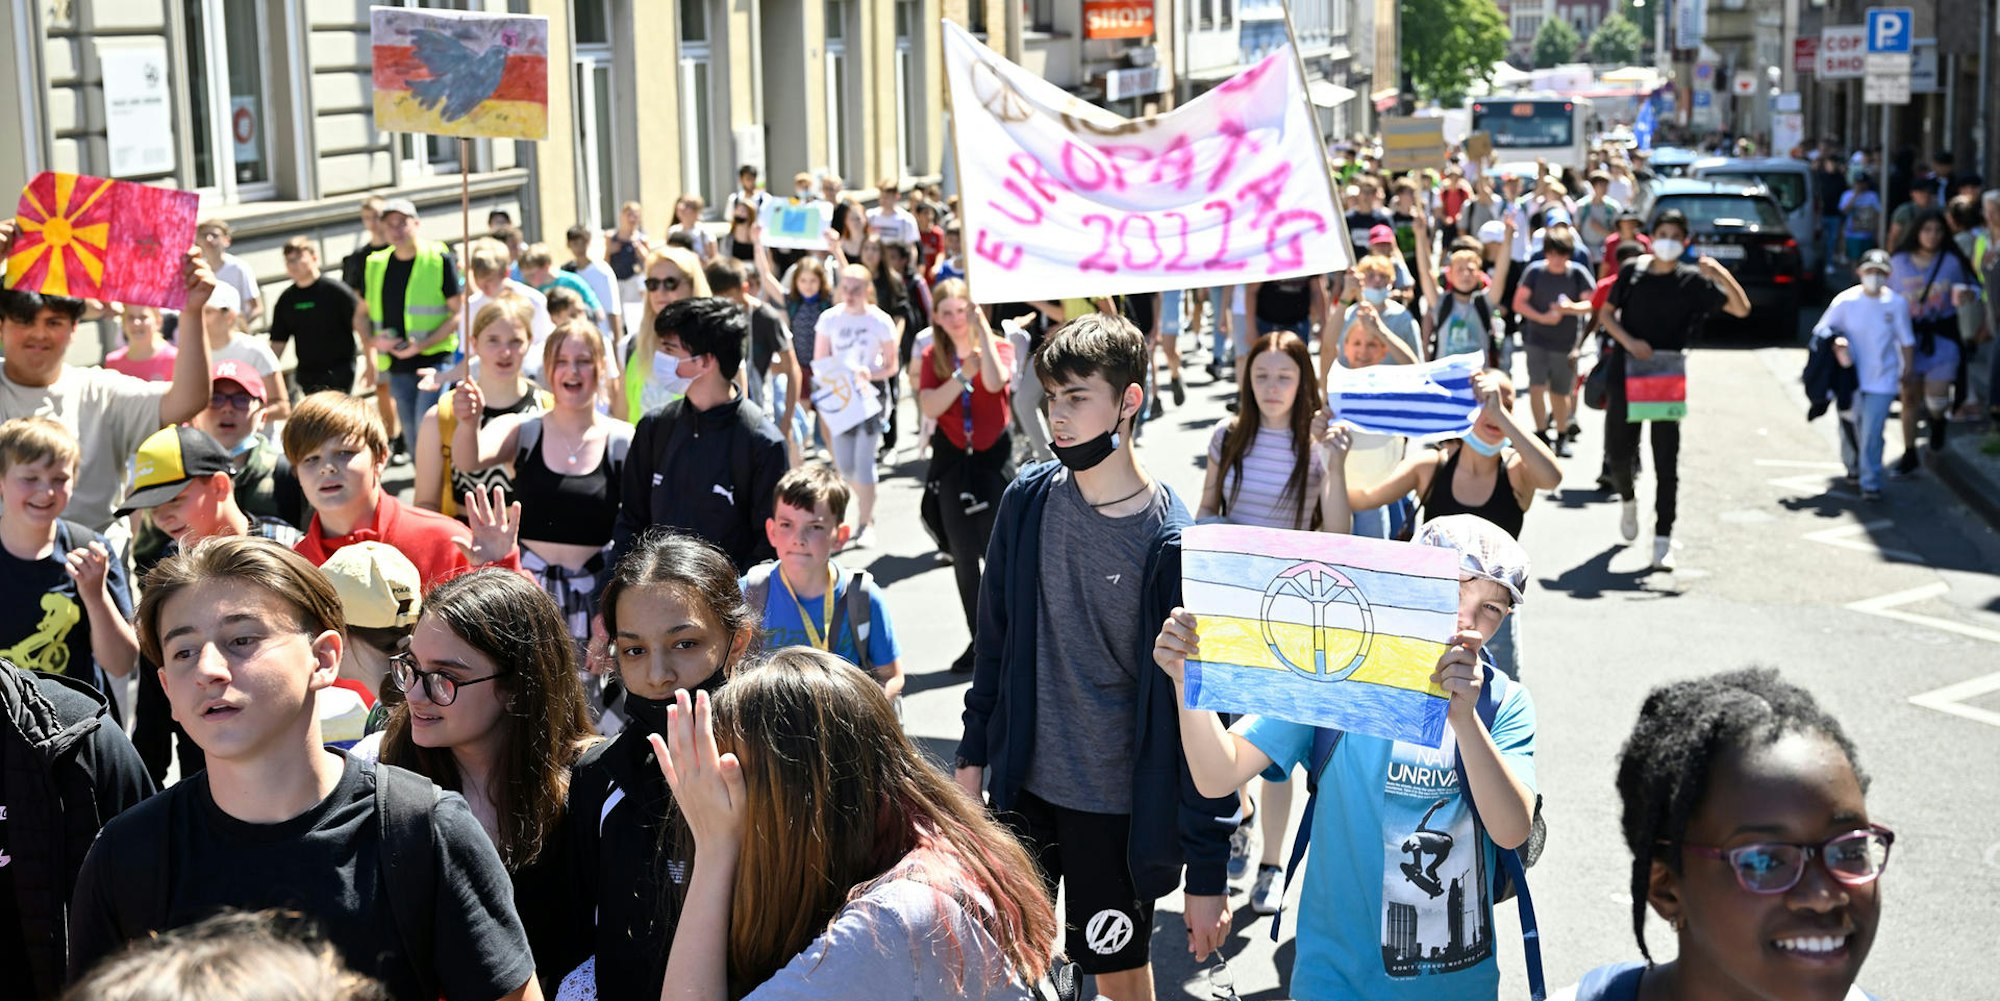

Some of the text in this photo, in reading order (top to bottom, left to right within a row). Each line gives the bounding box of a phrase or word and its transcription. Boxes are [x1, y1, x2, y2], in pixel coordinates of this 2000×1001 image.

[1087, 7, 1152, 29] SHOP
[1876, 13, 1903, 50] P
[1826, 37, 1863, 51] COP
[1826, 57, 1863, 71] SHO
[1078, 200, 1248, 273] 2022
[1416, 747, 1455, 769] NAT
[1387, 761, 1461, 788] UNRIVA
